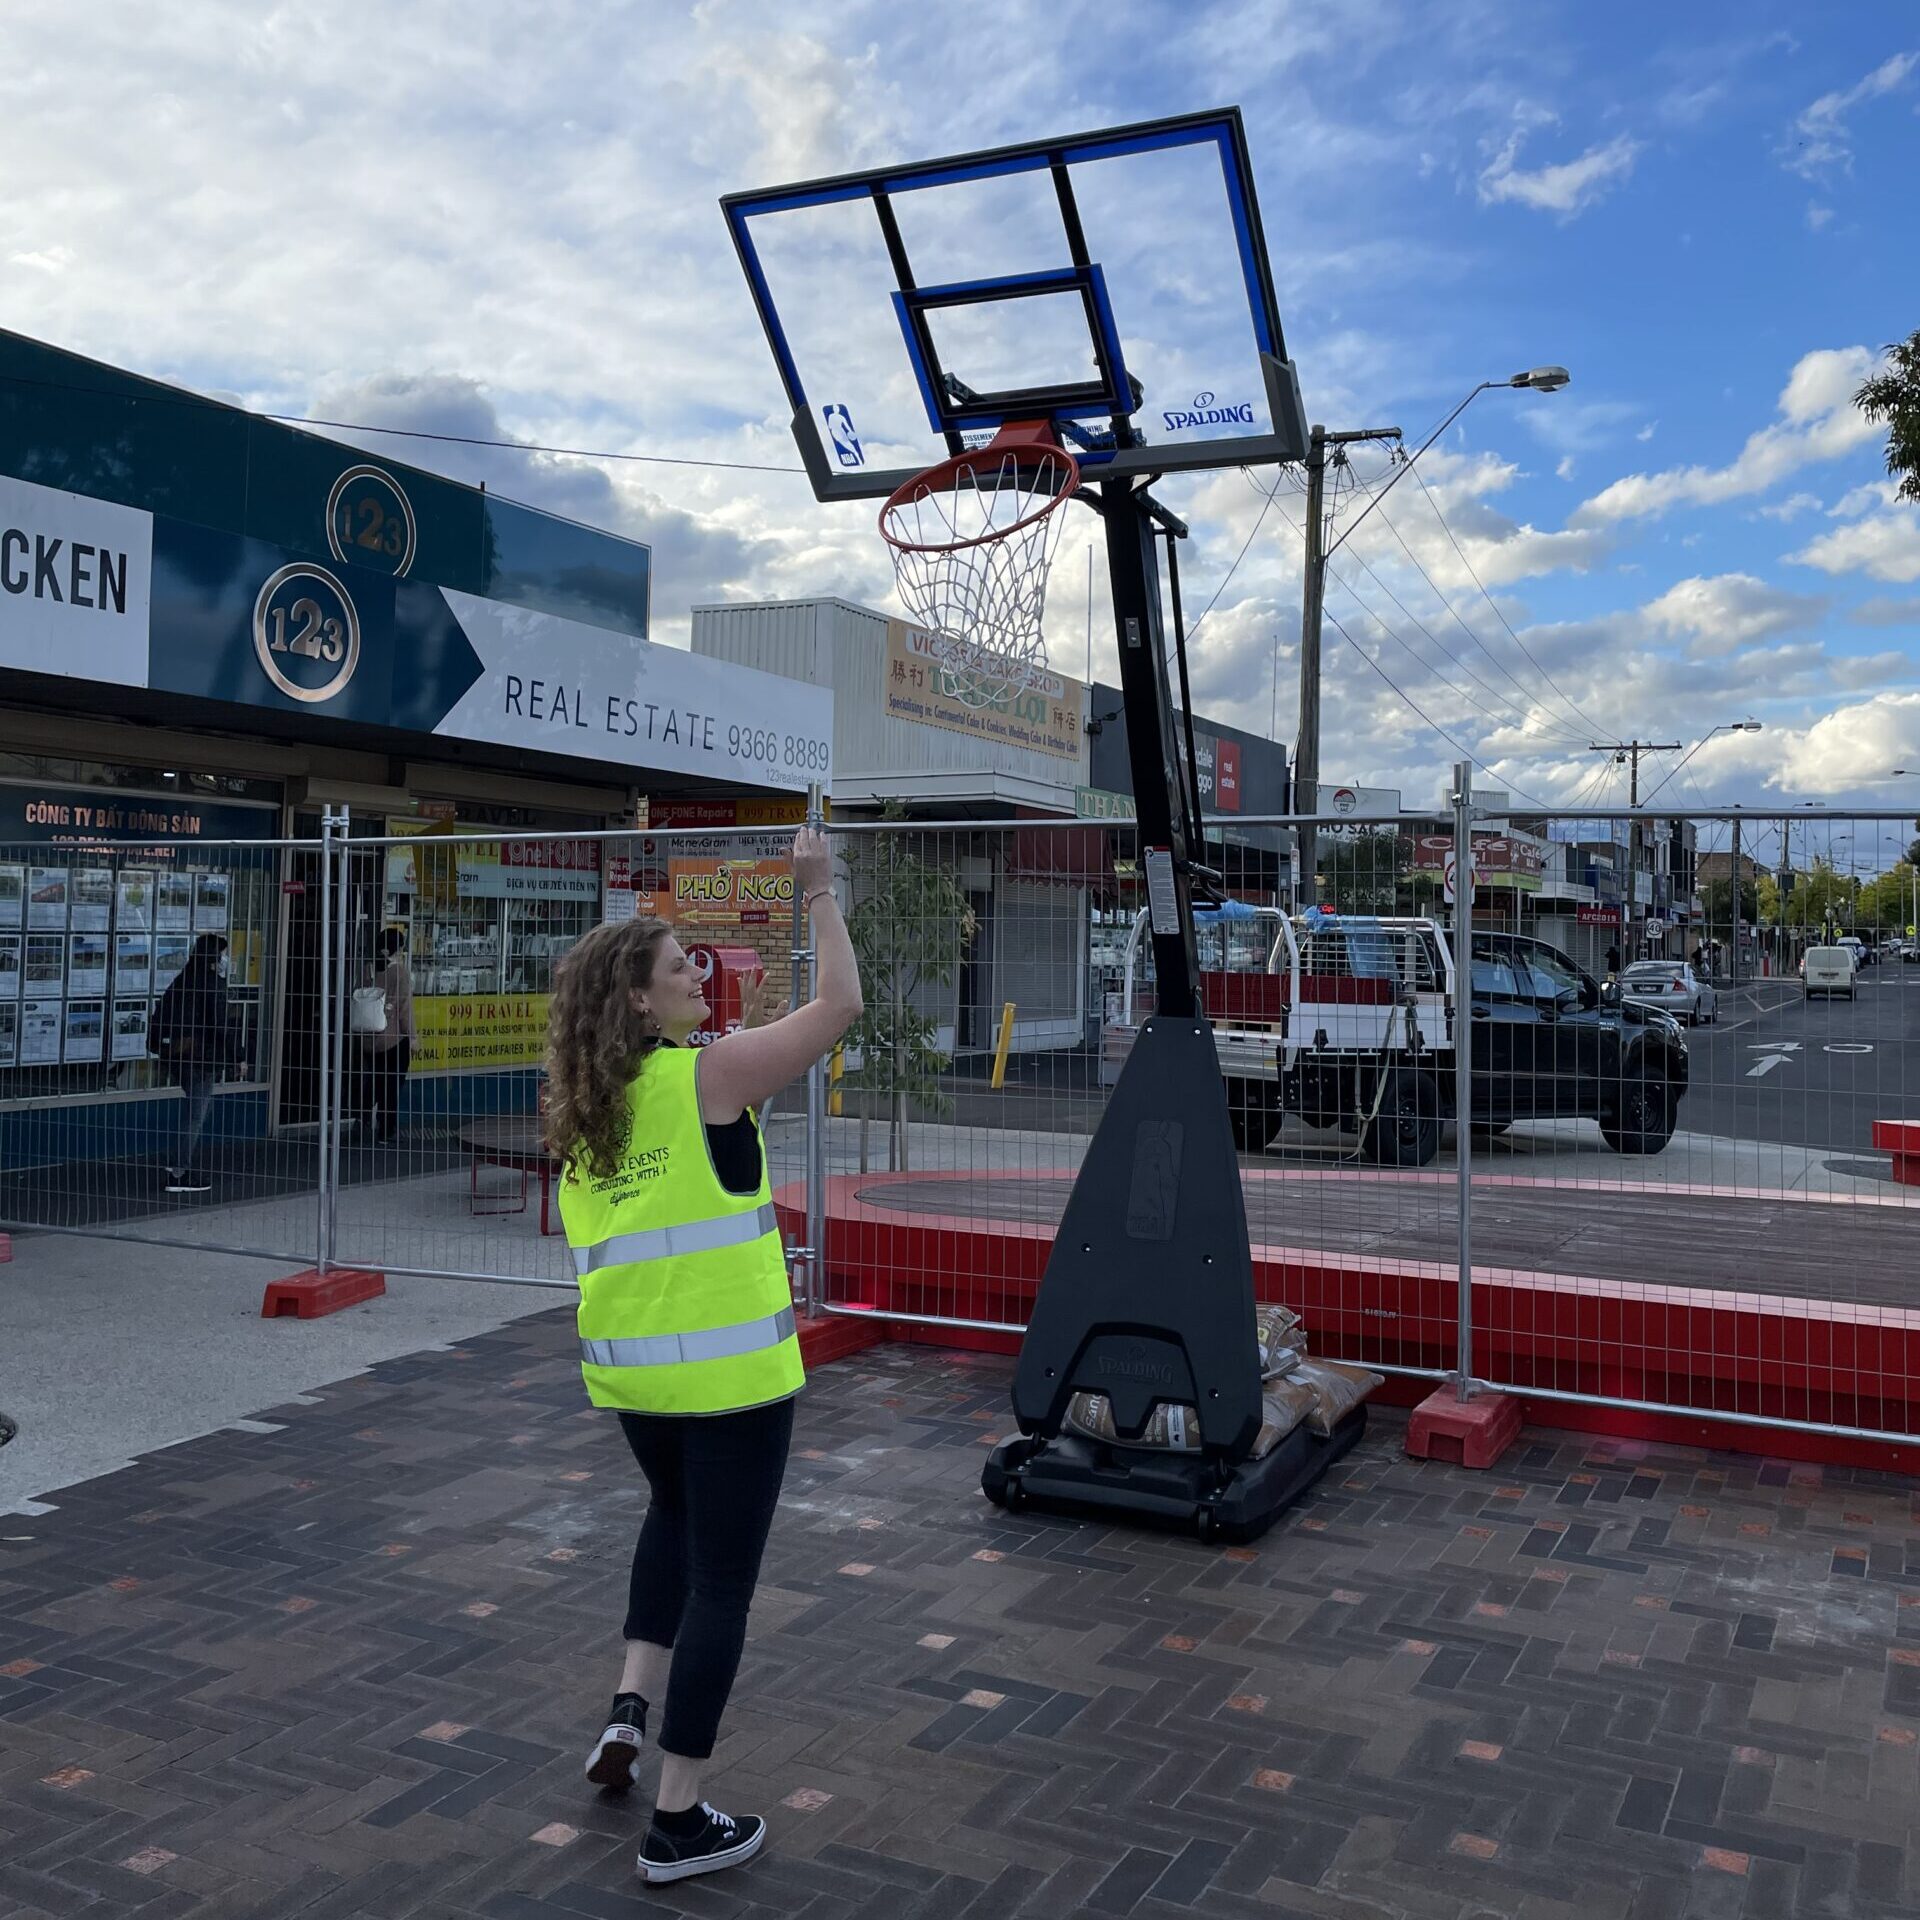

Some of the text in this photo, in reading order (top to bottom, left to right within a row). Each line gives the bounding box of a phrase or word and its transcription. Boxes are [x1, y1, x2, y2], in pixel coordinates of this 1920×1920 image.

[1163, 402, 1254, 432] SPALDING
[963, 432, 995, 442] TISSEMENT
[840, 453, 857, 465] NBA
[341, 496, 402, 557] 123
[1, 528, 127, 614] CKEN
[270, 597, 344, 662] 123
[505, 675, 829, 772] REAL ESTATE 9366 8889
[889, 692, 924, 719] Specialising
[934, 704, 966, 725] Continental
[966, 713, 980, 729] Cake
[1008, 724, 1030, 745] Wedding
[1030, 730, 1042, 744] Cake
[1223, 761, 1233, 773] real
[25, 800, 70, 825] CÔNG
[74, 807, 92, 827] TY
[651, 805, 734, 821] ONE FONE Repairs
[676, 865, 733, 903] PHỞ
[1649, 924, 1662, 936] 40
[477, 1002, 534, 1019] TRAVEL
[688, 1030, 721, 1045] OST
[628, 1147, 670, 1170] EVENTS
[590, 1174, 634, 1194] CONSULTING
[636, 1166, 660, 1181] WITH
[1096, 1355, 1174, 1385] SPALDING
